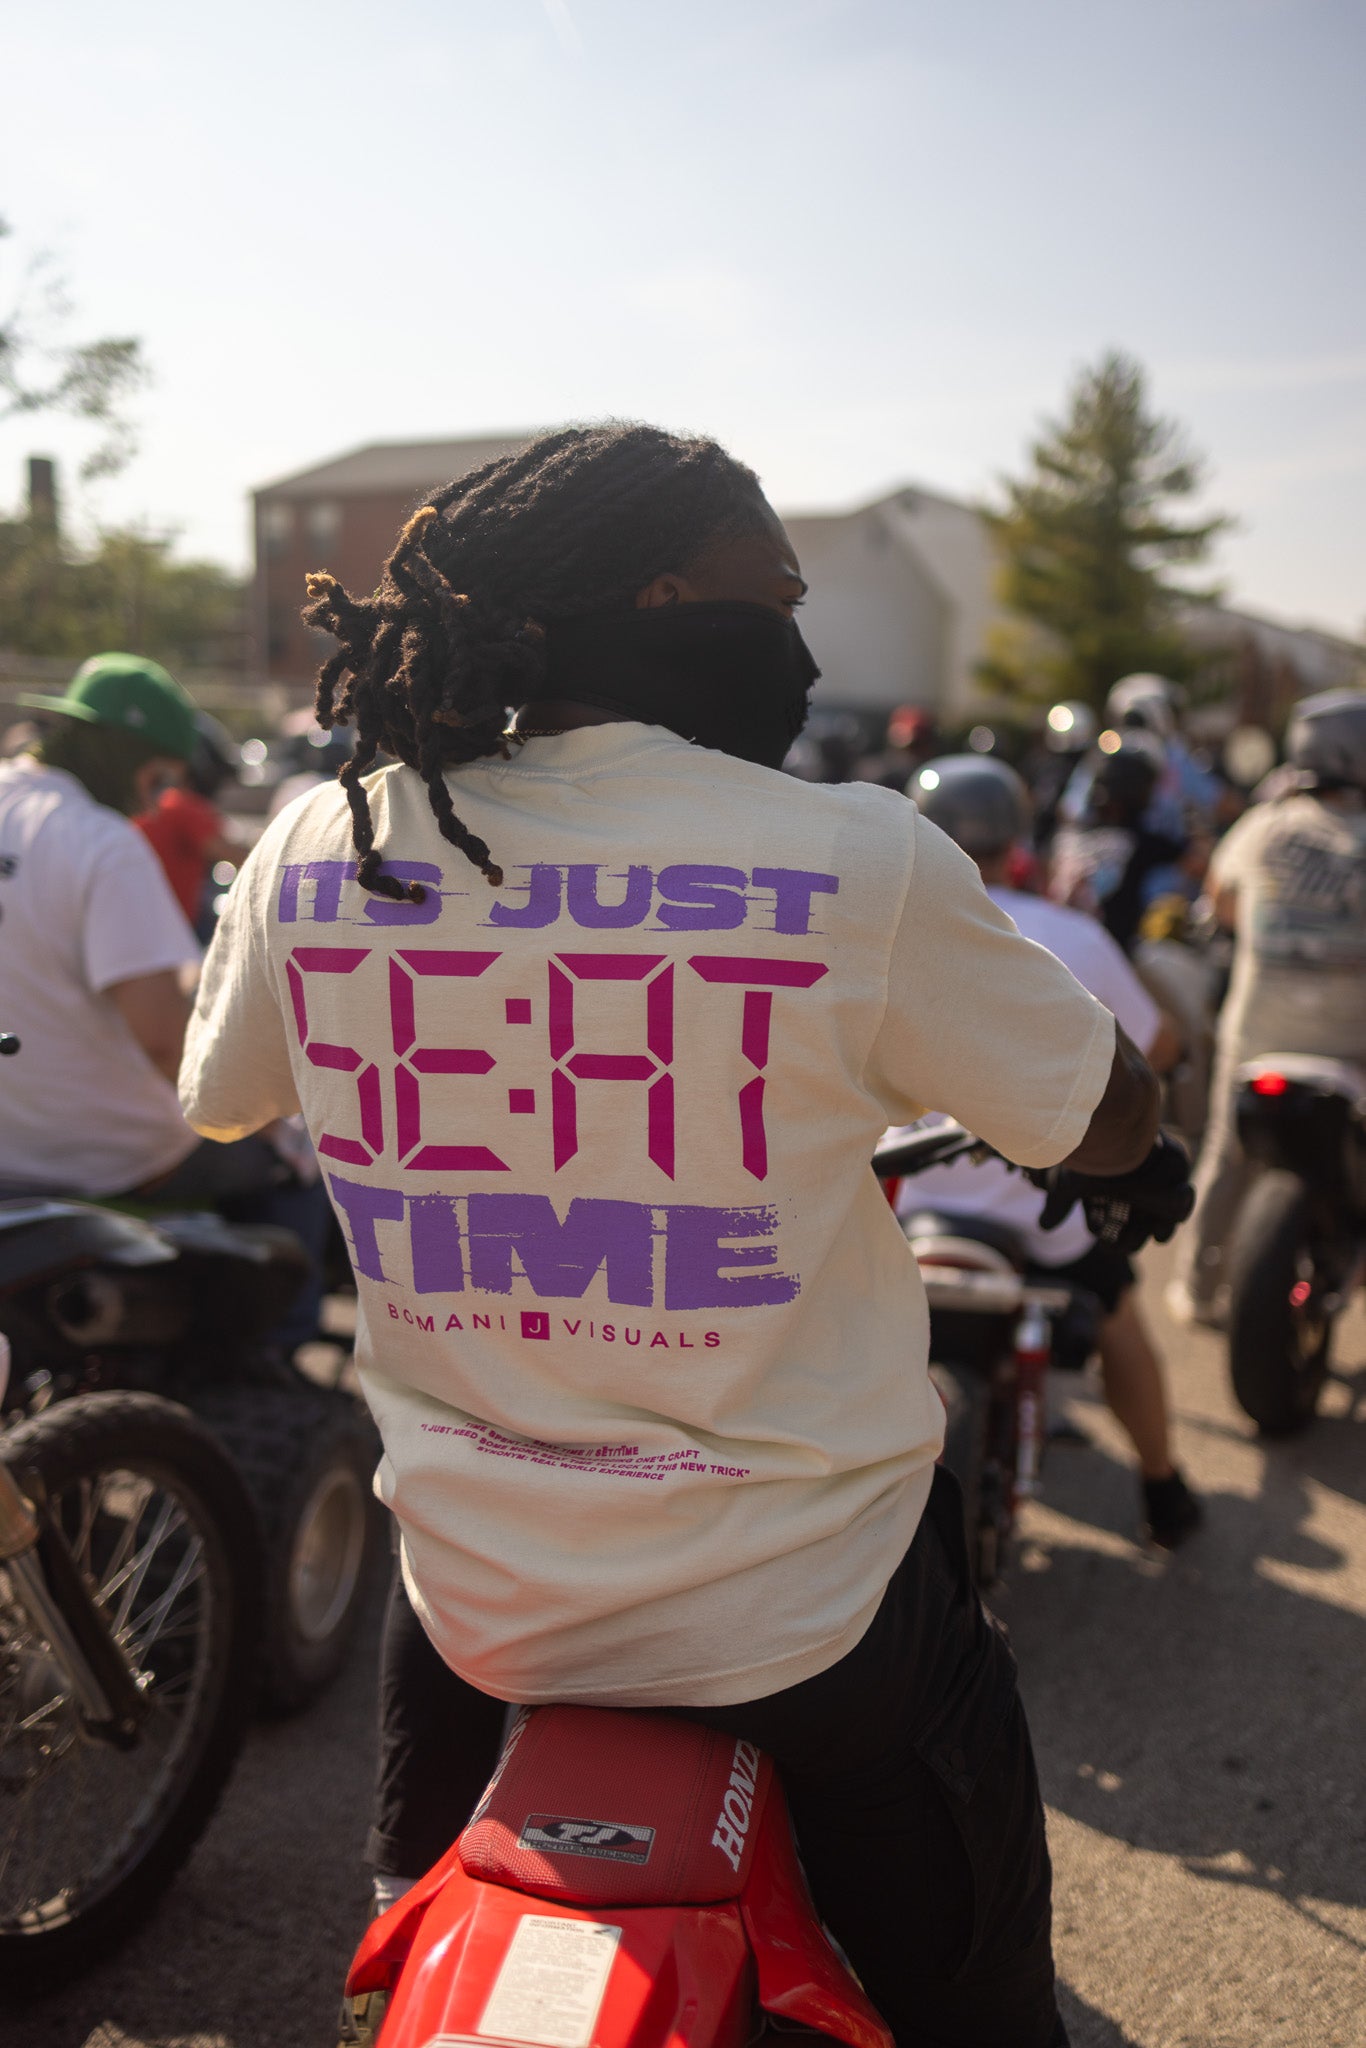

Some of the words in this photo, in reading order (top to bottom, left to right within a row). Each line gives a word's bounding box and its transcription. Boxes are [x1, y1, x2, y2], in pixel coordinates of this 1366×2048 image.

[477, 862, 840, 935] JUST
[327, 1172, 801, 1310] TIME
[388, 1303, 506, 1333] BOMANI
[563, 1319, 721, 1348] VISUALS
[428, 1424, 452, 1434] JUST
[452, 1428, 478, 1439] NEED
[479, 1437, 508, 1450] SOME
[510, 1446, 539, 1456] MORE
[540, 1453, 568, 1461] SEAT
[656, 1463, 678, 1471] THIS
[679, 1462, 707, 1473] NEW
[710, 1464, 750, 1478] TRICK"
[465, 1422, 488, 1433] TIME
[488, 1430, 521, 1446] SPENT
[635, 1454, 666, 1463] ONE'S
[668, 1449, 700, 1461] CRAFT
[476, 1446, 528, 1460] SYNONYM:
[530, 1457, 556, 1467] REAL
[559, 1462, 597, 1472] WORLD
[598, 1468, 665, 1480] EXPERIENCE
[533, 1439, 561, 1451] SEAT
[562, 1448, 585, 1456] TIME
[711, 1738, 761, 1873] HOND
